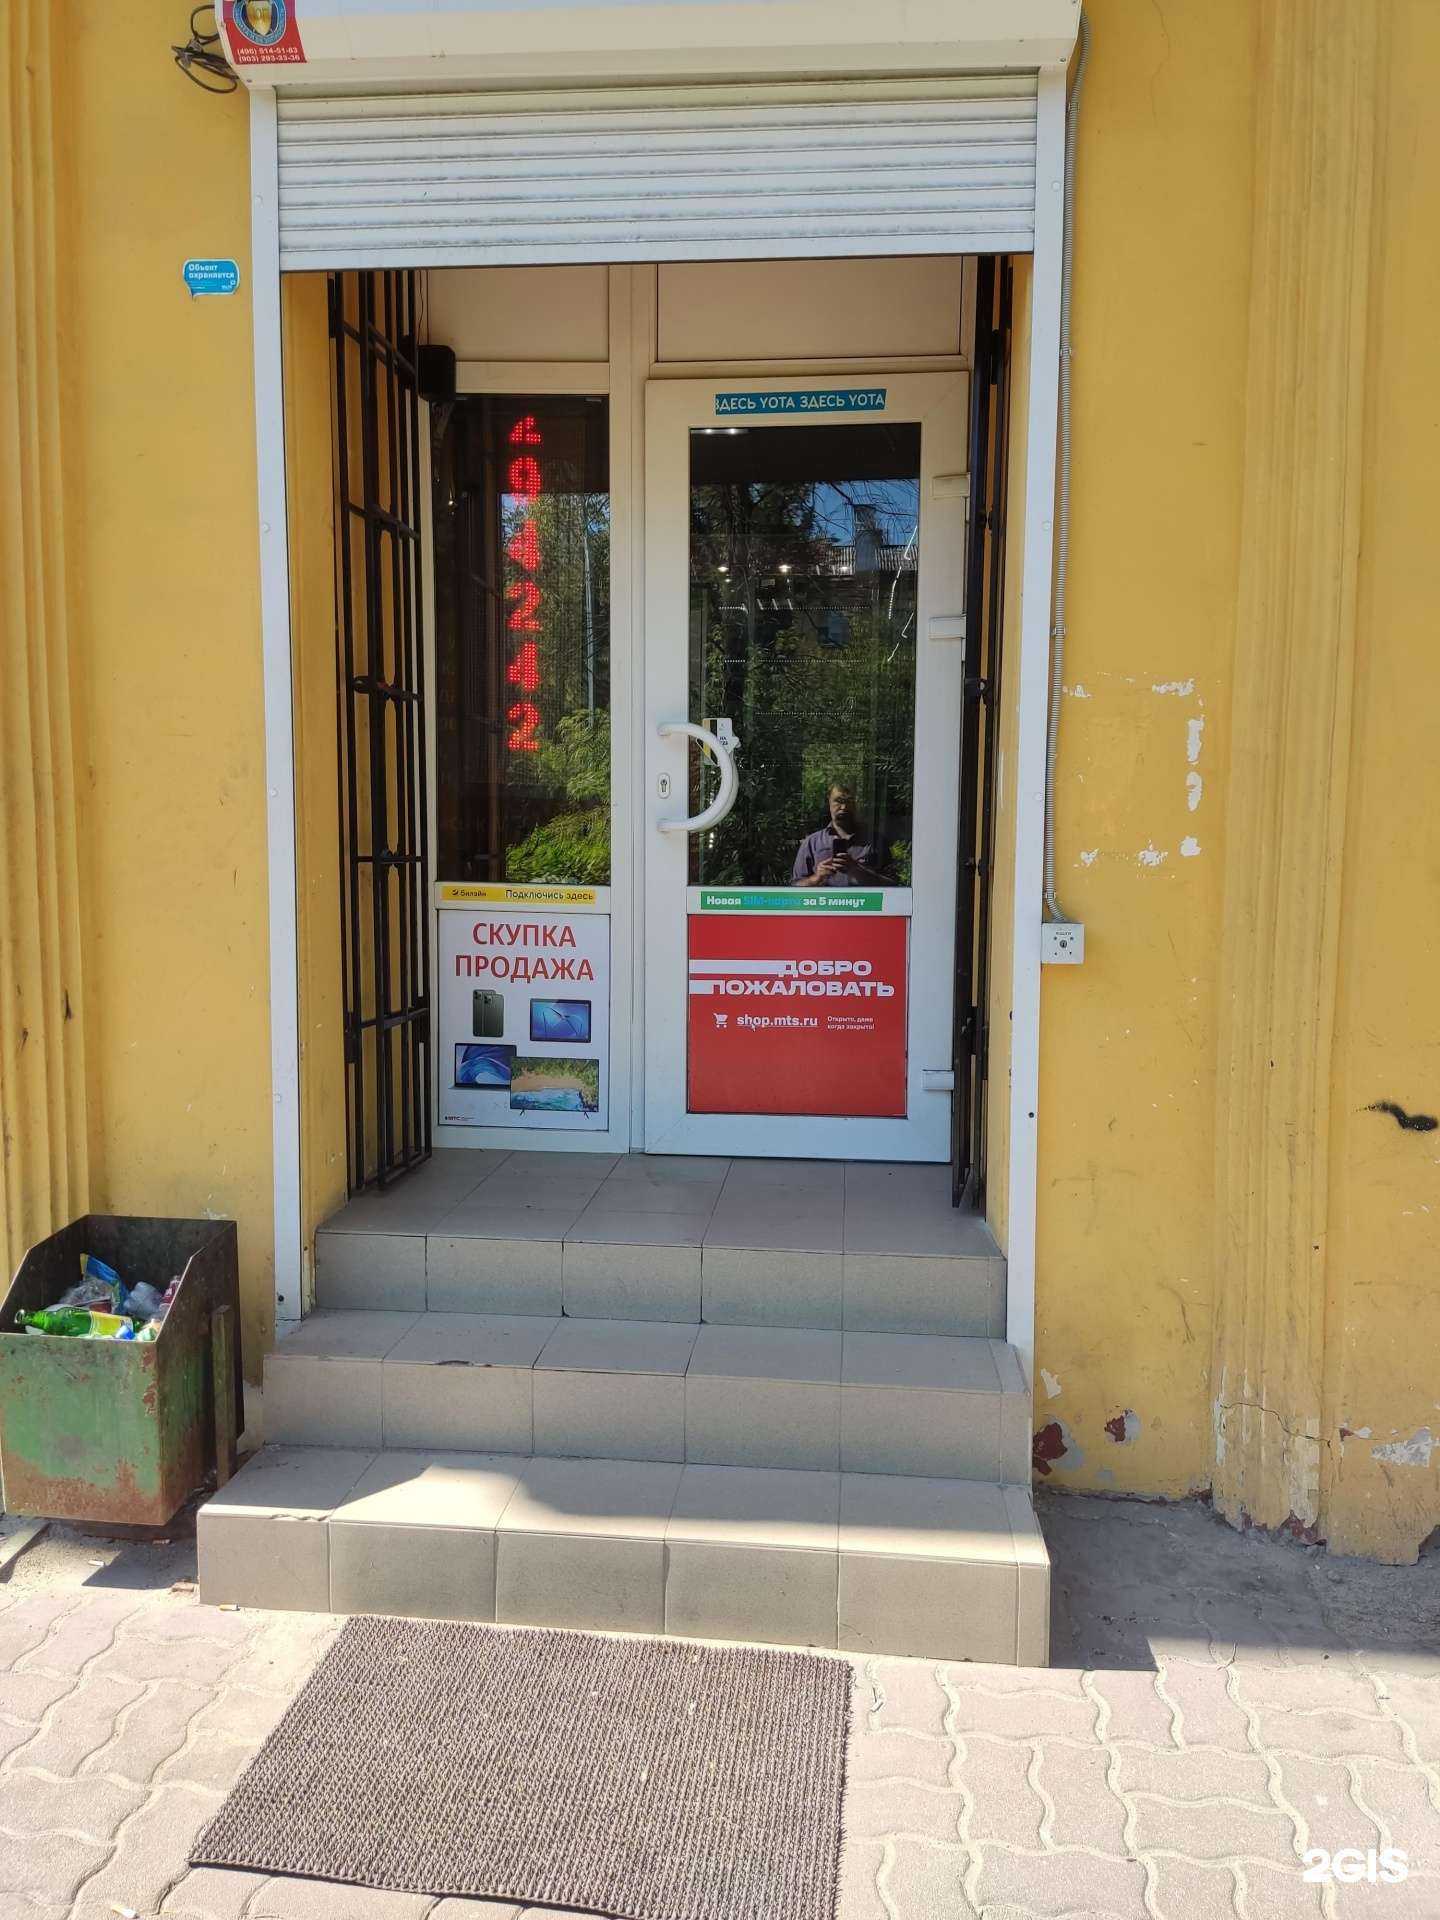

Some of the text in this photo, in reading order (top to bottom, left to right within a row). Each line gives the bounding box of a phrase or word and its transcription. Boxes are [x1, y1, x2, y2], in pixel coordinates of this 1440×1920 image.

[760, 396, 795, 409] YOTA
[800, 395, 845, 409] ЗДЕСЬ
[849, 393, 885, 406] YOTA
[505, 889, 593, 901] Подключись здесь
[706, 895, 742, 906] Новая
[802, 897, 817, 907] за
[818, 896, 827, 906] 5
[828, 898, 866, 908] минут
[472, 922, 577, 948] СКУПКА
[455, 954, 594, 984] ПРОДАЖА
[777, 960, 873, 978] ДОБРО
[711, 979, 895, 998] ПОЖАЛОВАТЬ
[736, 1014, 818, 1028] shop.mts.ru
